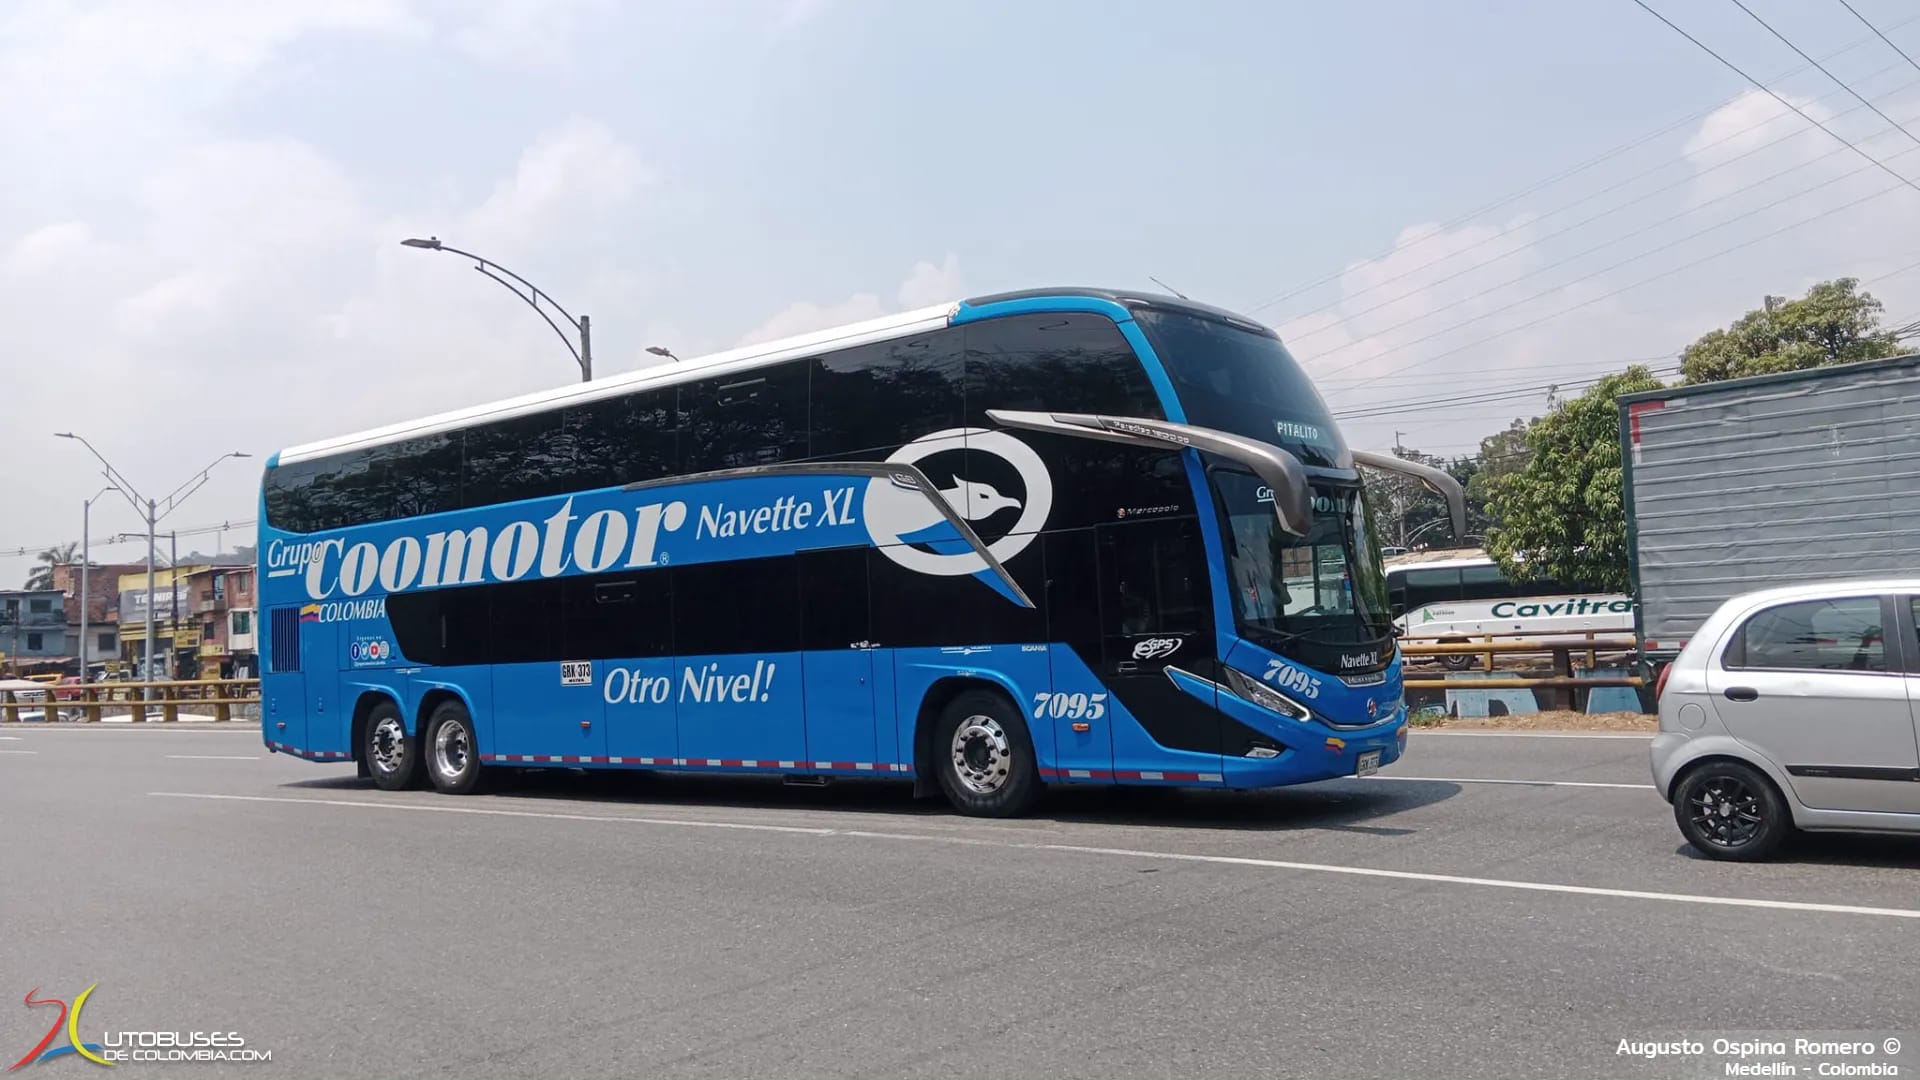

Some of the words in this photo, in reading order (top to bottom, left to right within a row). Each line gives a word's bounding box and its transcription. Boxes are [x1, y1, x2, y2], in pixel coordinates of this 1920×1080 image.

[1277, 421, 1318, 440] PITALITO
[696, 495, 812, 540] Navette
[816, 487, 856, 526] XL
[267, 538, 323, 575] Grupo
[305, 496, 687, 600] Coomotor
[318, 599, 386, 623] COLOMBIA
[1340, 653, 1370, 669] Navette
[1370, 651, 1378, 665] XL
[603, 668, 670, 704] Otro
[679, 660, 776, 703] Nivel!
[1263, 659, 1322, 699] 7095
[1033, 692, 1107, 720] 7095
